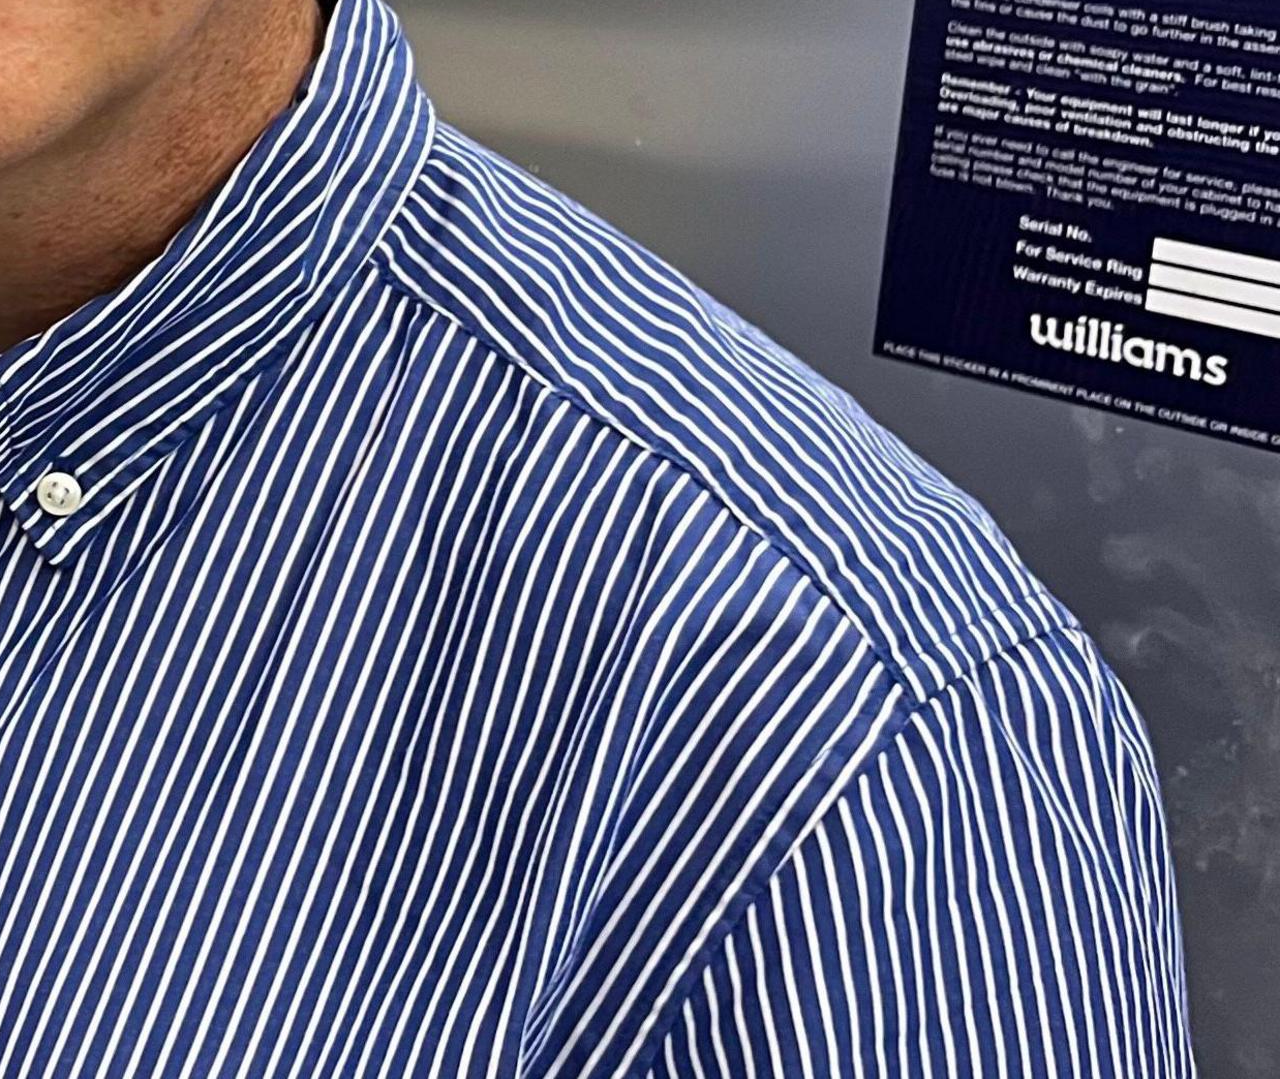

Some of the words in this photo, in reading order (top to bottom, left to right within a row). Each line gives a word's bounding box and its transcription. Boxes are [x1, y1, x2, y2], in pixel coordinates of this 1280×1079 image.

[1019, 215, 1063, 237] Serial
[1065, 224, 1092, 243] No.
[1015, 240, 1042, 258] For
[1045, 246, 1103, 271] Service
[1106, 258, 1143, 282] Ring
[1013, 265, 1082, 294] Warranty
[1084, 279, 1143, 305] Expires
[1030, 313, 1228, 386] williams
